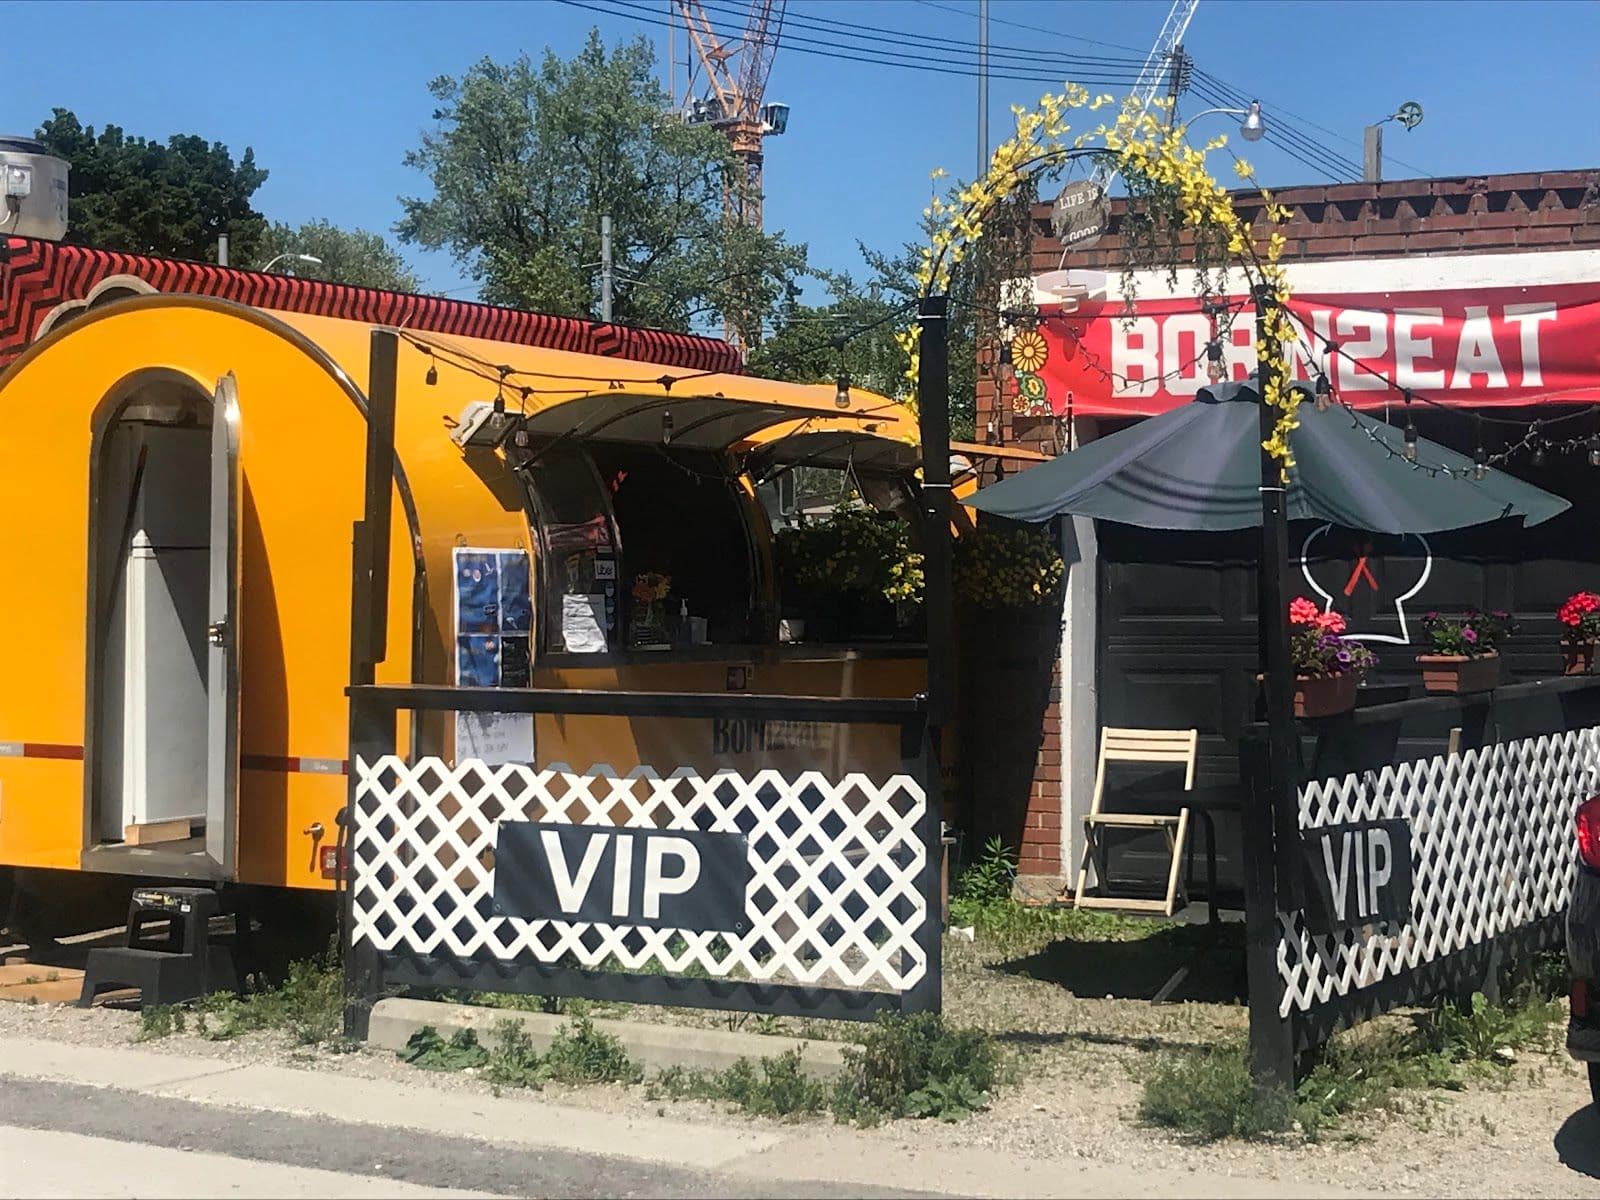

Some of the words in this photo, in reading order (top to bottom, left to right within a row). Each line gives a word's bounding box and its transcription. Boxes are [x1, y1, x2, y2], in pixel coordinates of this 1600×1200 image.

[1060, 192, 1085, 210] LIFE
[1110, 302, 1558, 398] BORN2EAT
[540, 830, 701, 919] VIP
[1321, 828, 1392, 921] VIP
